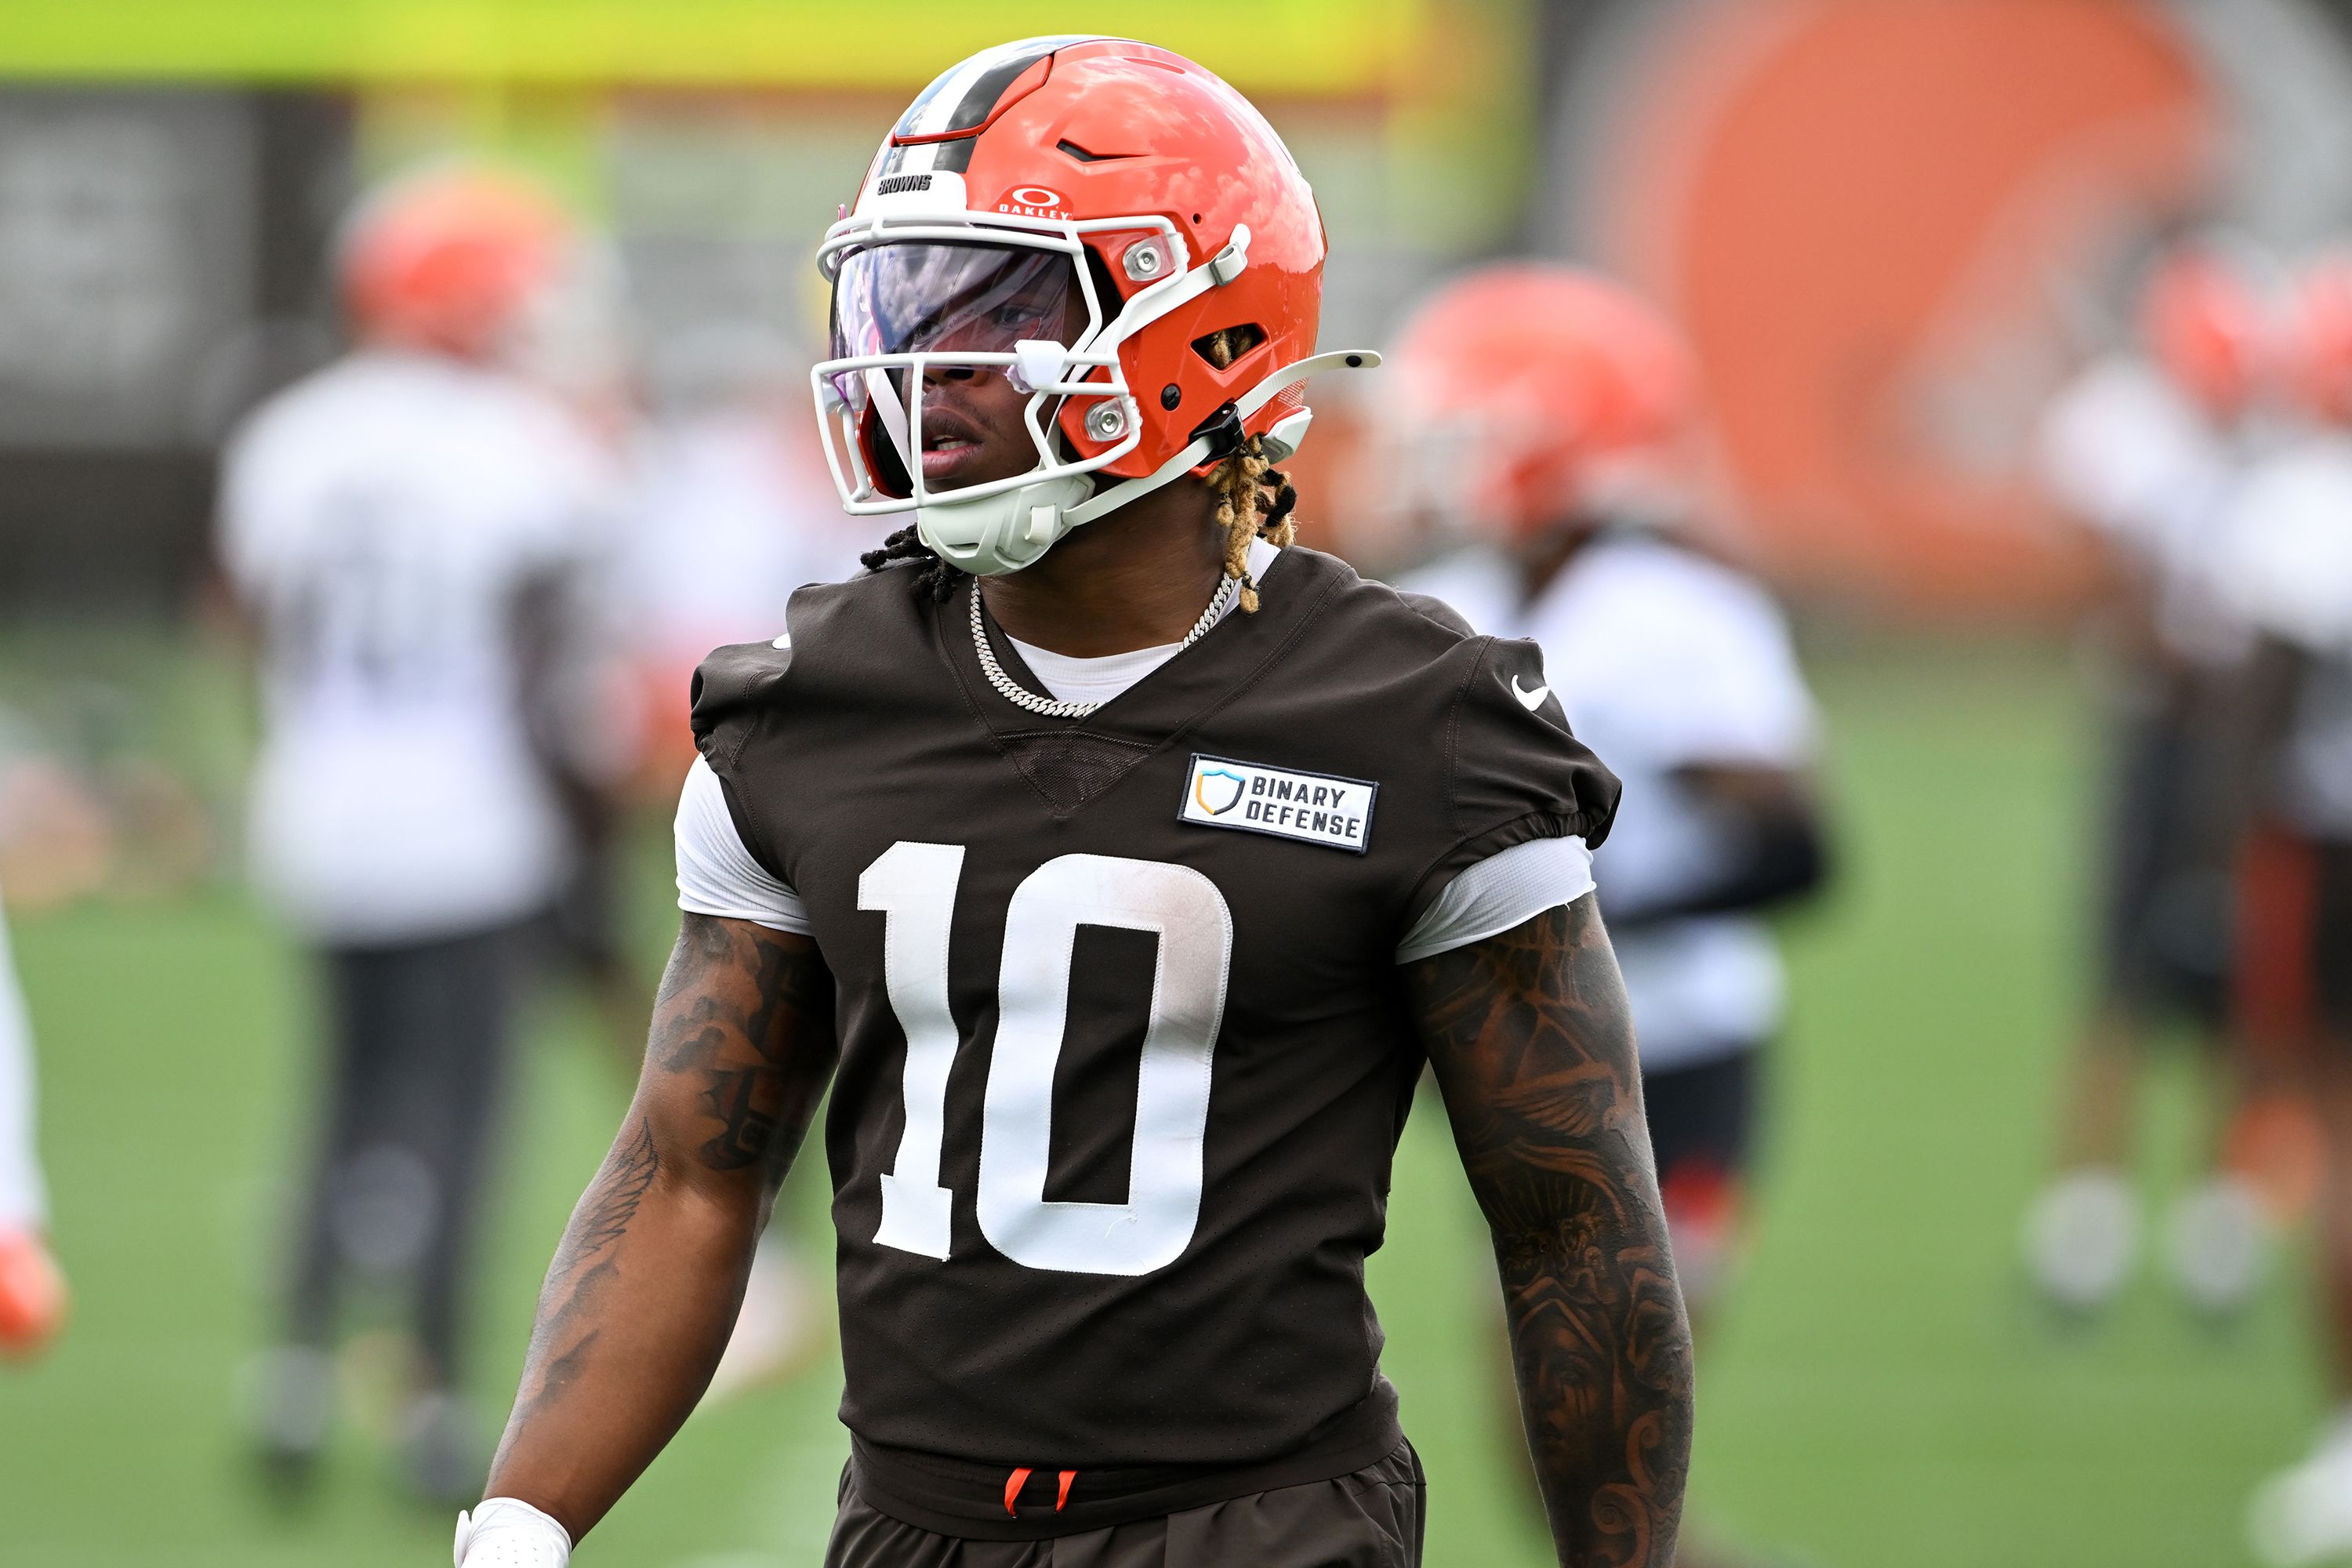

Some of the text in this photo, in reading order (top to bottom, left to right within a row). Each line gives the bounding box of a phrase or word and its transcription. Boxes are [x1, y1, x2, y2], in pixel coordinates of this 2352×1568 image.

[877, 174, 932, 195] BROWNS
[999, 204, 1069, 220] OAKLEY
[1251, 776, 1345, 808] BINARY
[1246, 800, 1360, 838] DEFENSE
[857, 840, 1233, 1276] 10
